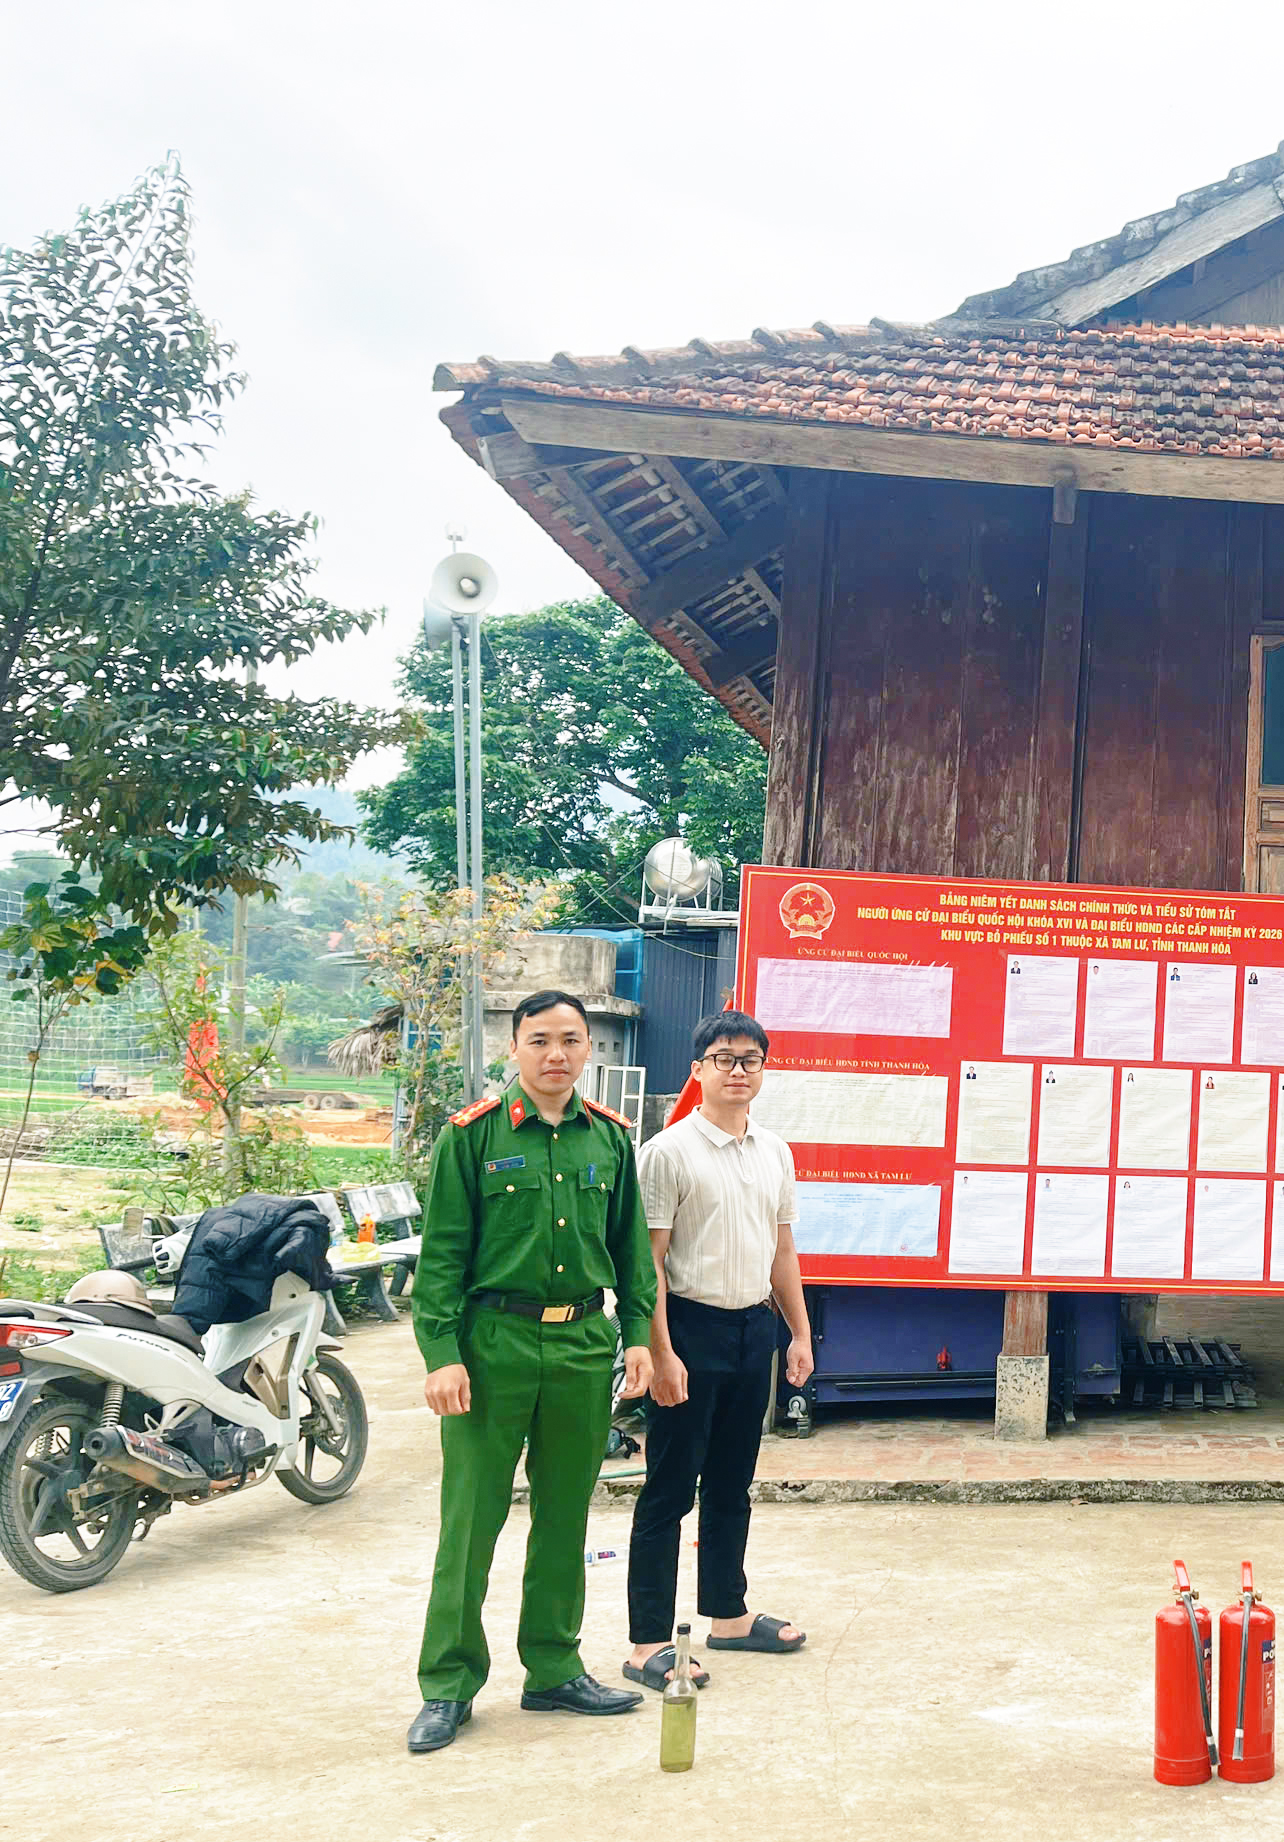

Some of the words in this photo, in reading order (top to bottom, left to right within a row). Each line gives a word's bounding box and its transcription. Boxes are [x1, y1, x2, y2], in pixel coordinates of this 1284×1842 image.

[940, 892, 968, 906] BẢNG
[970, 894, 996, 908] NIÊM
[1000, 894, 1017, 908] YẾT
[1020, 898, 1046, 910] DANH
[1050, 897, 1076, 912] SÁCH
[1080, 901, 1110, 914] CHÍNH
[1112, 903, 1137, 915] THỨC
[1140, 904, 1152, 916] VÀ
[1156, 902, 1176, 917] TIỂU
[1180, 904, 1194, 918] SỬ
[1195, 907, 1216, 919] TÓM
[1219, 906, 1236, 920] TẮT
[858, 906, 888, 920] NGƯỜI
[891, 907, 912, 920] ỨNG
[916, 907, 930, 921] CỬ
[932, 912, 949, 924] ĐẠI
[952, 909, 975, 924] BIỂU
[978, 910, 1004, 925] QUỐC
[1007, 914, 1024, 927] HỘI
[1026, 914, 1054, 928] KHÓA
[1056, 916, 1072, 928] XVI
[1075, 916, 1088, 929] VÀ
[1090, 919, 1108, 933] ĐẠI
[1110, 916, 1132, 932] BIỂU
[1165, 921, 1185, 935] CÁC
[1188, 921, 1206, 936] CẤP
[1210, 924, 1242, 939] NHIỆM
[1244, 925, 1256, 938] KỲ
[1259, 928, 1282, 940] 2026
[941, 930, 962, 941] KHU
[964, 931, 984, 944] VỰC
[987, 928, 1000, 943] BỎ
[1003, 930, 1032, 944] PHIẾU
[1035, 932, 1050, 945] SỐ
[1052, 935, 1057, 946] 1
[1060, 933, 1092, 948] THUỘC
[1096, 936, 1108, 948] XÃ
[1112, 938, 1132, 950] TAM
[1134, 939, 1149, 952] LƯ,
[1152, 938, 1174, 951] TỈNH
[1177, 942, 1209, 953] THANH
[1211, 941, 1231, 954] HÓA
